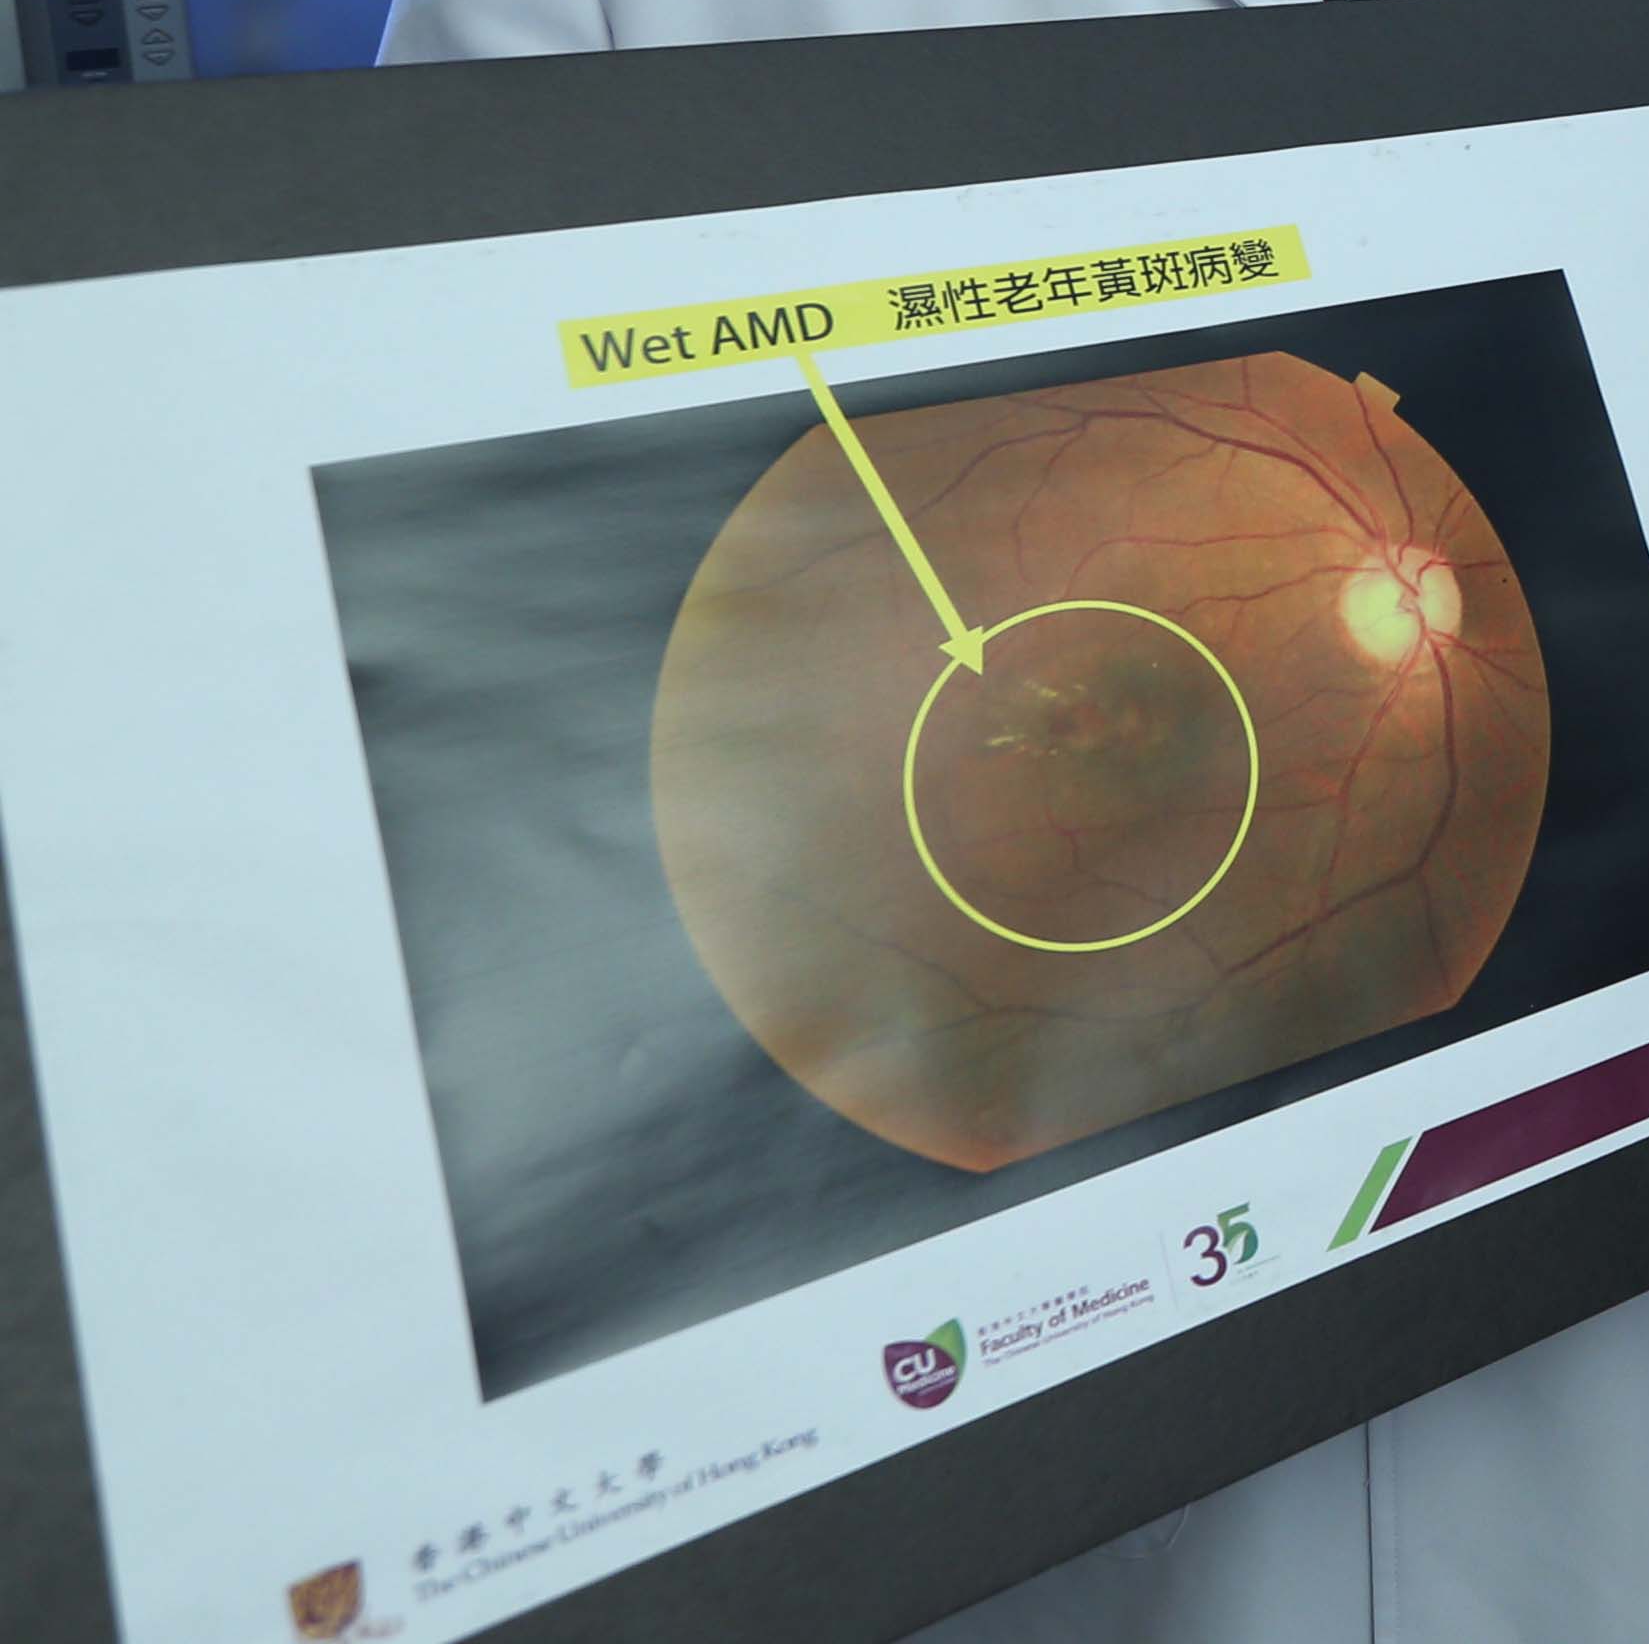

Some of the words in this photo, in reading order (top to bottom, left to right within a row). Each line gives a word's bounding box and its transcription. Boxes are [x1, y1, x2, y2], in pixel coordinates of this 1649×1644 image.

[888, 238, 1280, 331] 濕性老年黃斑病變
[580, 325, 696, 372] Wet
[711, 302, 833, 356] AMD
[979, 1320, 1044, 1357] Faculty
[1049, 1308, 1067, 1329] of
[1072, 1278, 1150, 1320] Medicine
[892, 1348, 938, 1383] CU
